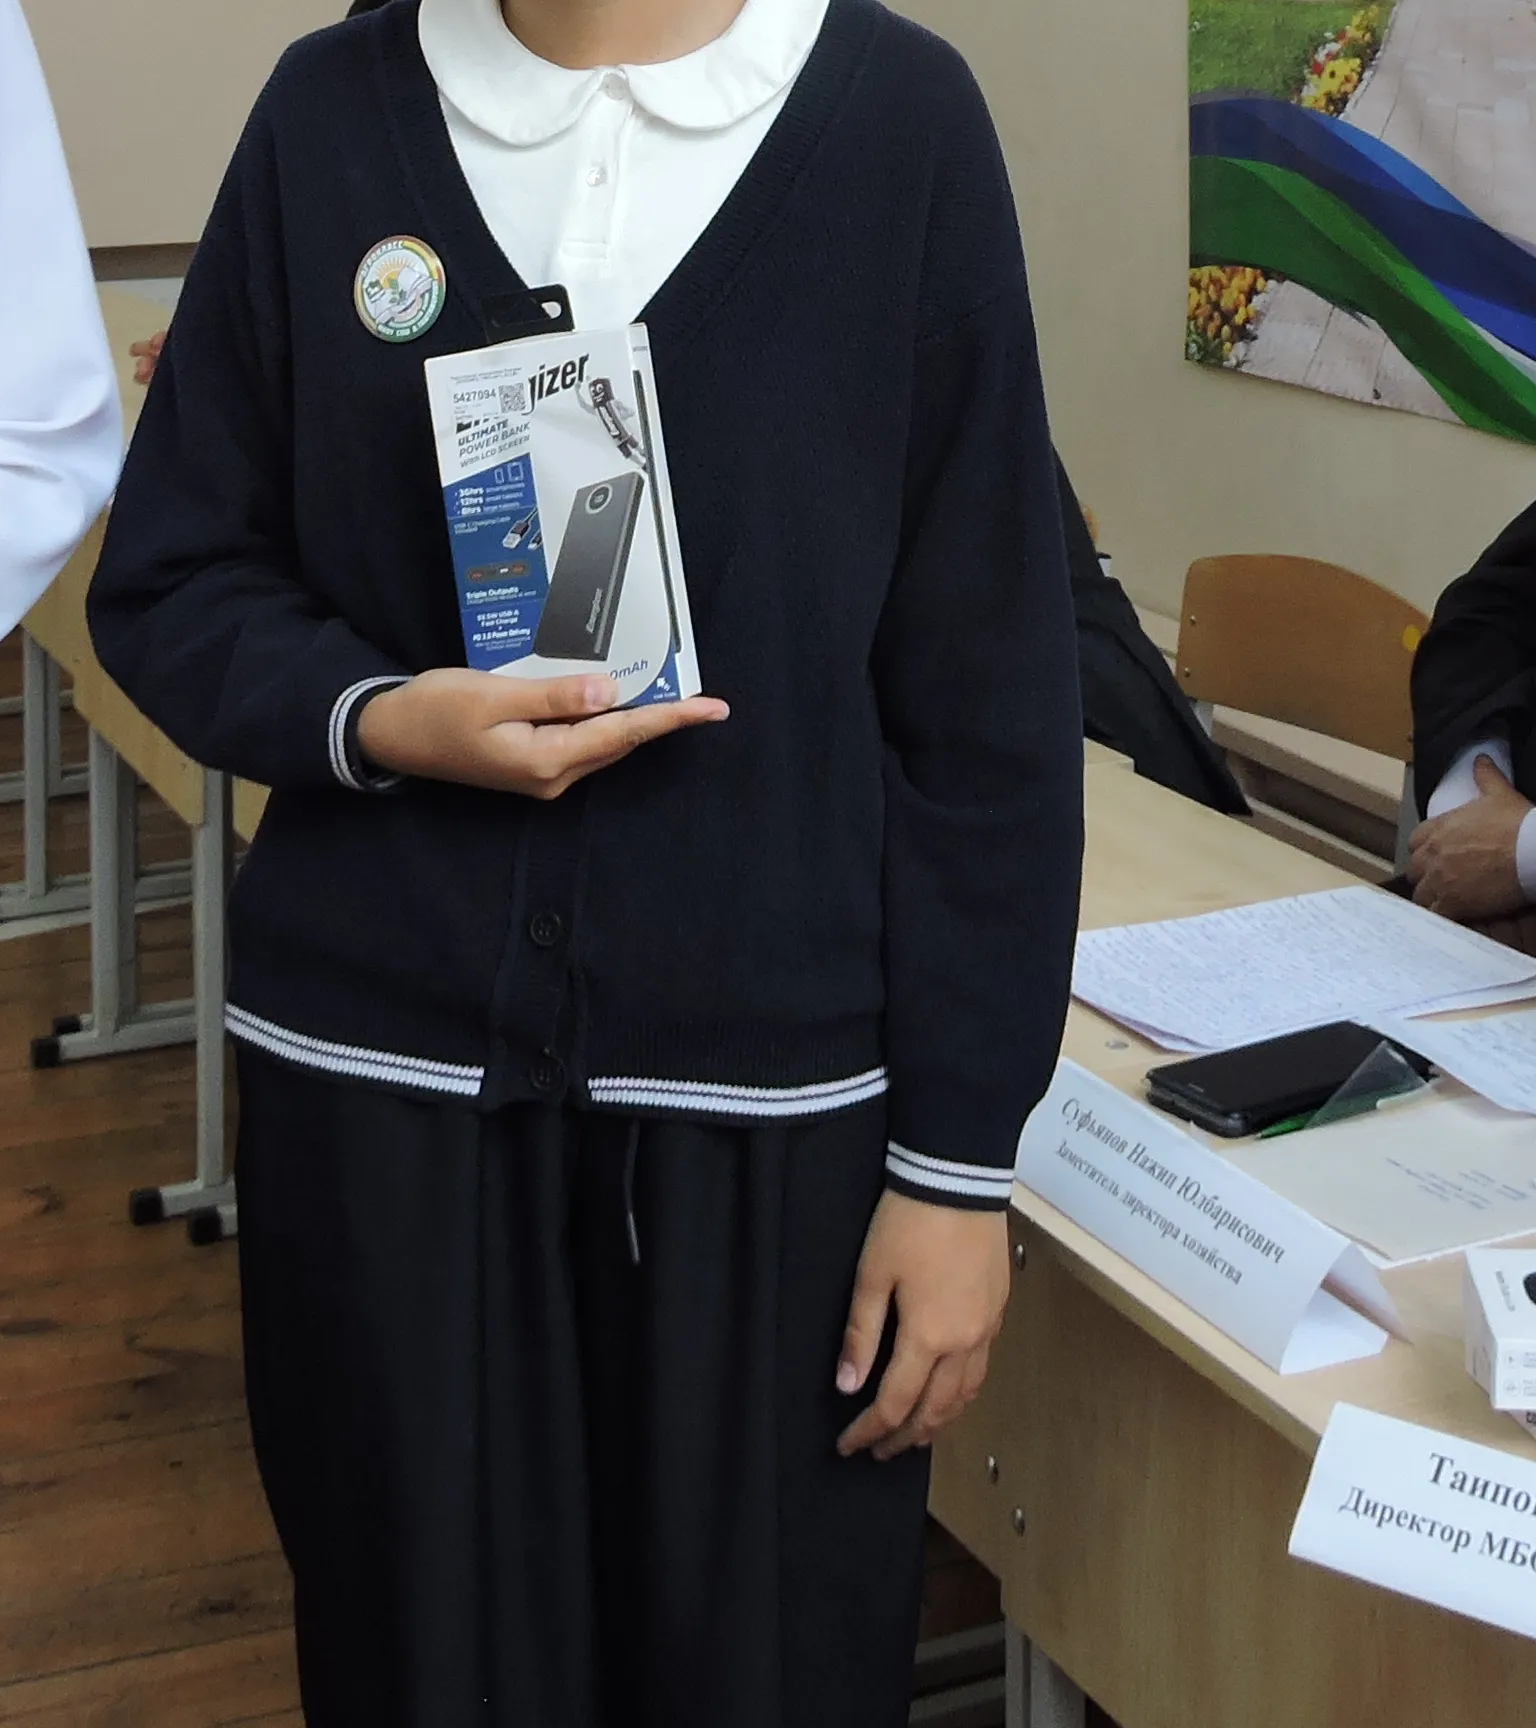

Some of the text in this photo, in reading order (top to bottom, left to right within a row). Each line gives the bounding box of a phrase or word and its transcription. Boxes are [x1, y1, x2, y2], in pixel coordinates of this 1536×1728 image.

[453, 388, 497, 404] 5427094
[458, 419, 509, 446] ULTIMATE
[459, 432, 499, 458] POWER
[501, 422, 531, 441] BANK
[481, 445, 496, 460] LCD
[498, 435, 530, 454] SCREEN
[1061, 1097, 1285, 1264] Суфьянов Нажип Юлбарисович
[1055, 1139, 1244, 1285] Заместитель директора хозяйства
[1338, 1486, 1472, 1554] Директор
